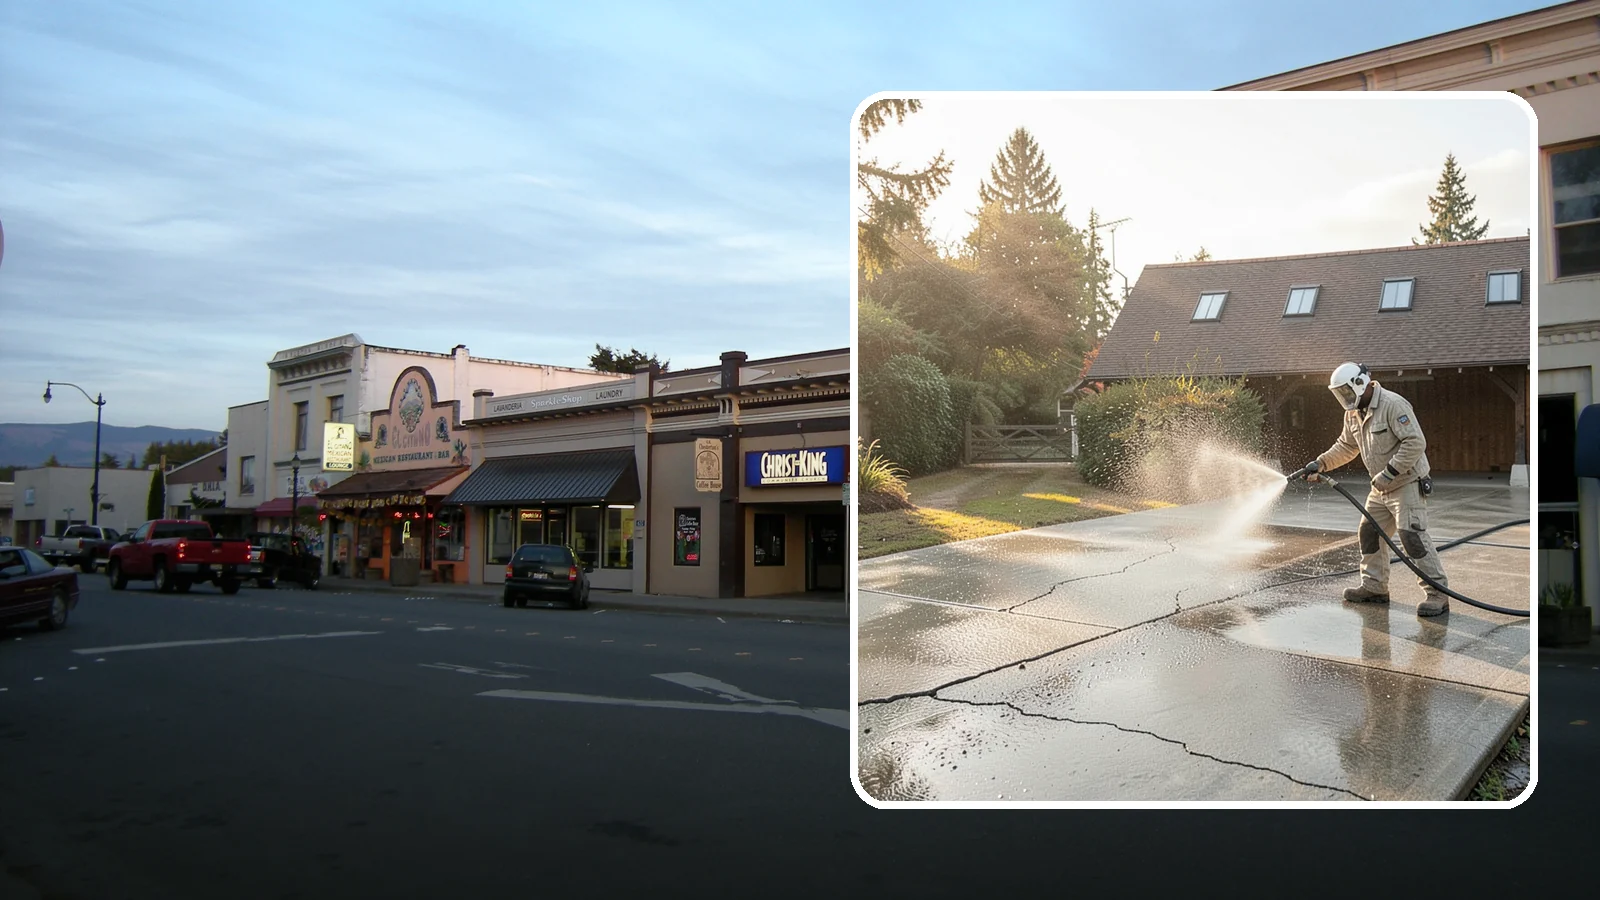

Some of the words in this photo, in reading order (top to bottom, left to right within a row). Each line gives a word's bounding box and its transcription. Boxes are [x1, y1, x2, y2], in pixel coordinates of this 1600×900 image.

[561, 393, 583, 405] Shop
[595, 389, 623, 400] LAUNDRY
[493, 401, 522, 413] LAVANDERIA
[373, 454, 396, 464] MEXICAN
[397, 451, 433, 462] RESTAURANT
[438, 450, 450, 459] BAR
[761, 452, 797, 478] CHRIST
[799, 450, 827, 476] KING
